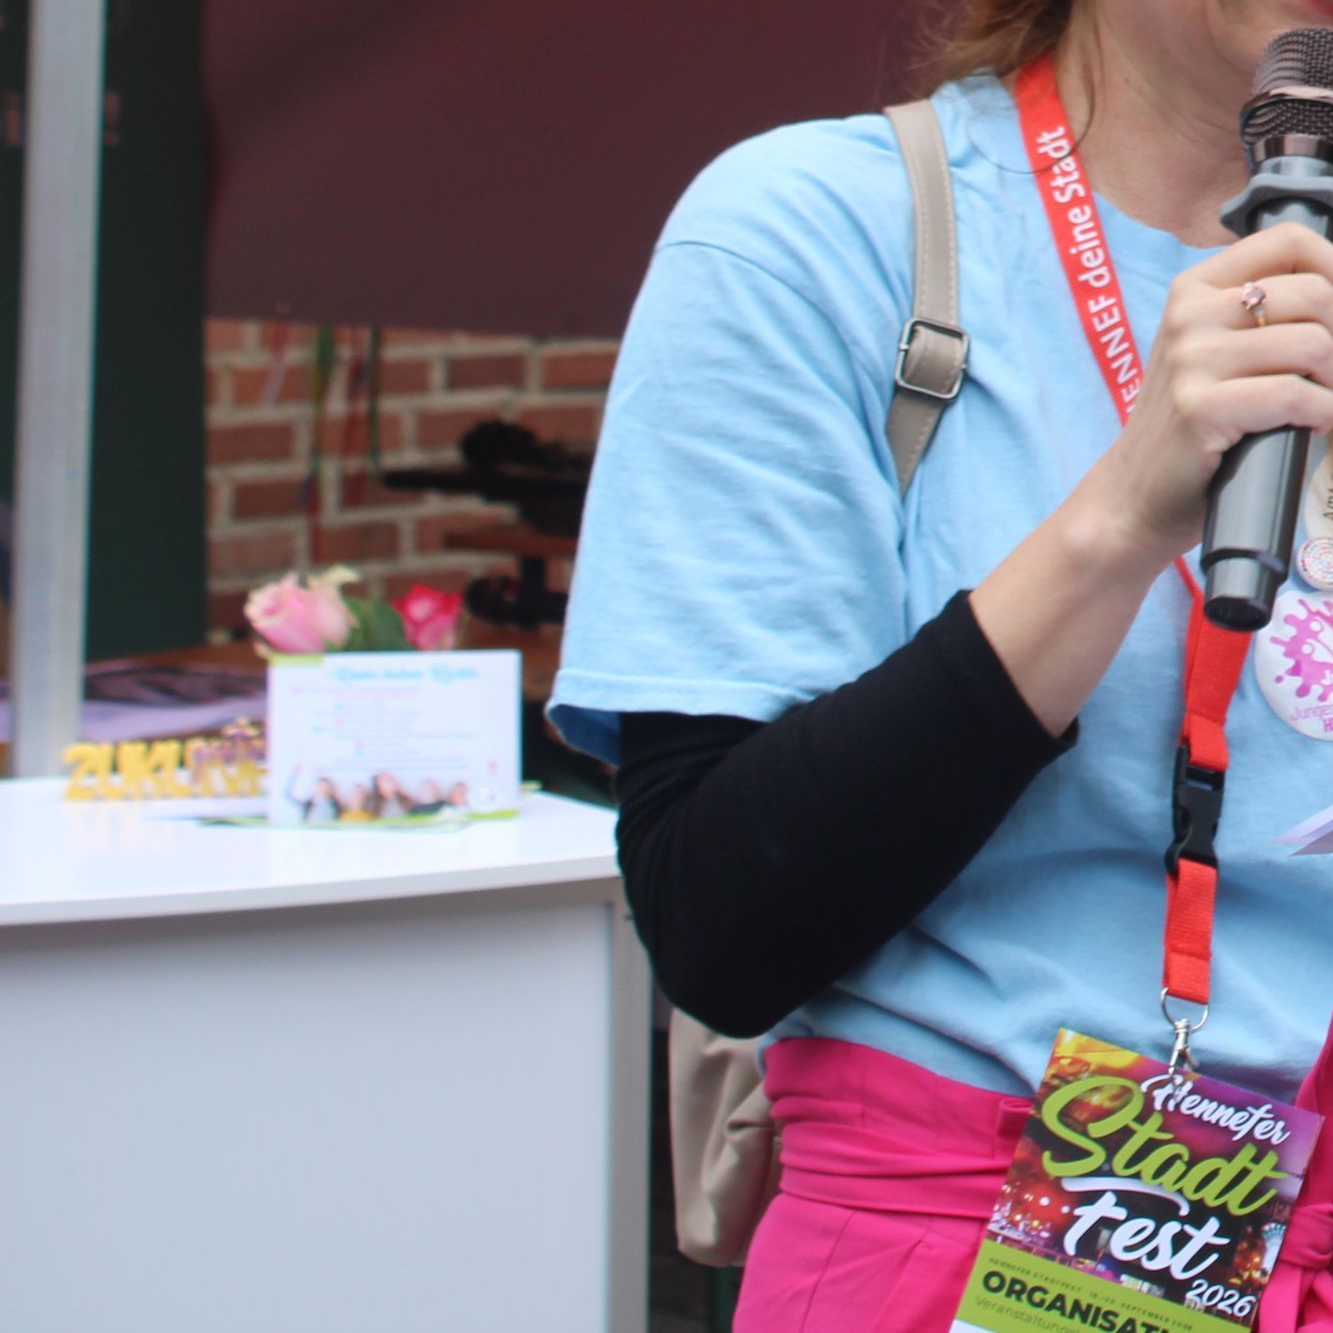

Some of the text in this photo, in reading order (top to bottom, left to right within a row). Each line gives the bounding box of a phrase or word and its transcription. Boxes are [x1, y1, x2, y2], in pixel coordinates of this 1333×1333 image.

[1035, 125, 1142, 414] ENNEF deine Stadt
[1041, 1075, 1290, 1216] Stadt
[1140, 1073, 1291, 1146] Hennefer
[1061, 1176, 1230, 1280] Fest
[982, 1270, 1169, 1333] ORGANISAT
[1185, 1280, 1256, 1319] 2026
